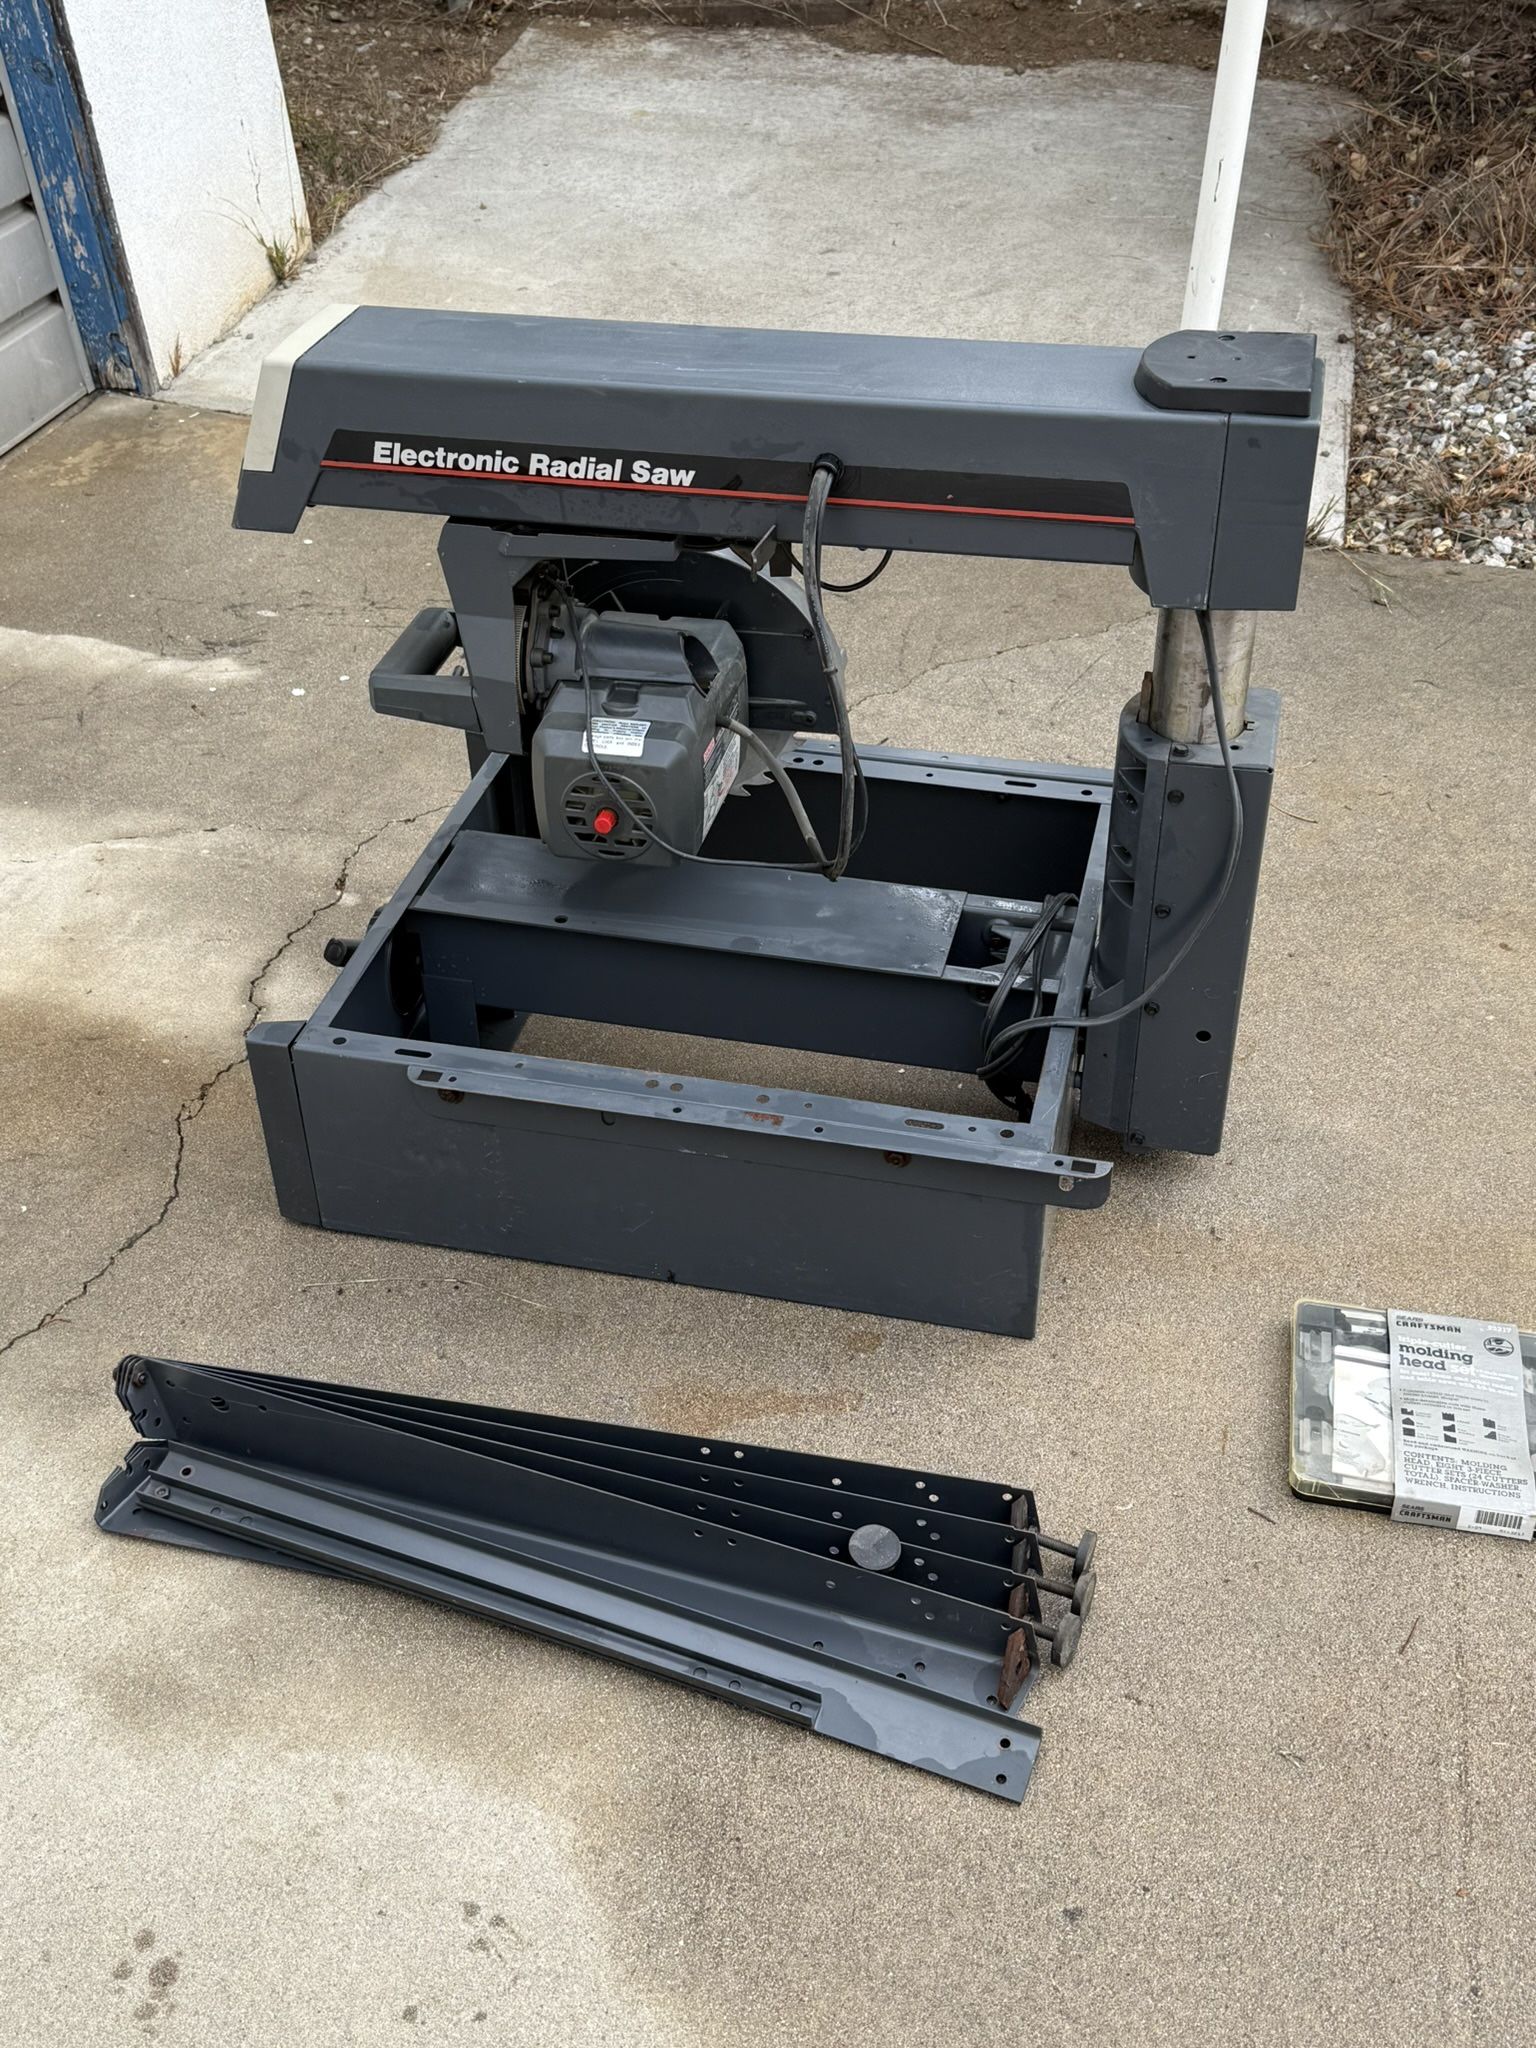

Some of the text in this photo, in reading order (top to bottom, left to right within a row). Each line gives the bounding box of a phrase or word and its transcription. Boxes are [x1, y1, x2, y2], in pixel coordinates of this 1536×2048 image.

[373, 441, 697, 488] Electronic Radial Saw
[1396, 1320, 1462, 1334] CRAFTSMAN
[1398, 1343, 1474, 1366] molding
[1399, 1353, 1447, 1371] head
[1450, 1364, 1476, 1377] set
[1435, 1461, 1464, 1471] EIGHT
[1467, 1465, 1502, 1476] 3-PIECE
[1461, 1459, 1508, 1472] MOLDING
[1403, 1463, 1443, 1475] CUTTER
[1444, 1468, 1467, 1478] SETS
[1484, 1475, 1529, 1486] CUTTERS
[1451, 1484, 1522, 1499] INSTRUCTIONS
[1399, 1510, 1452, 1524] CRAFTSMAN
